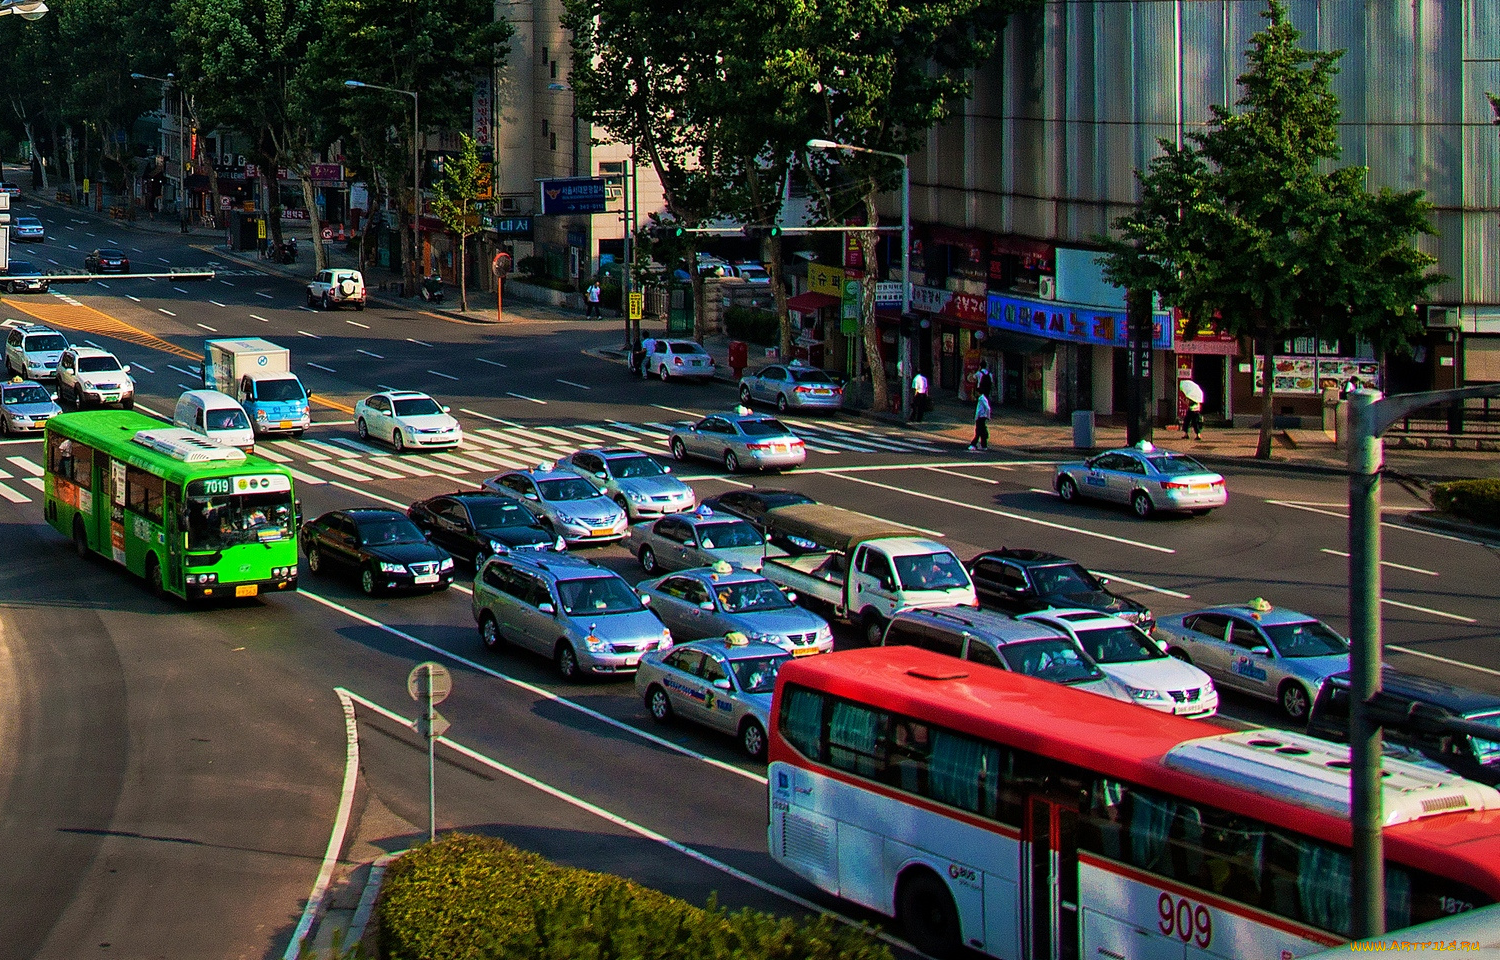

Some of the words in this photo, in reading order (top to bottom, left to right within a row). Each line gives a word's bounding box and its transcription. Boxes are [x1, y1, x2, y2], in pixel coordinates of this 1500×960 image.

[818, 271, 841, 290] 슈퍼
[205, 479, 229, 494] 7019
[1158, 891, 1211, 949] 909
